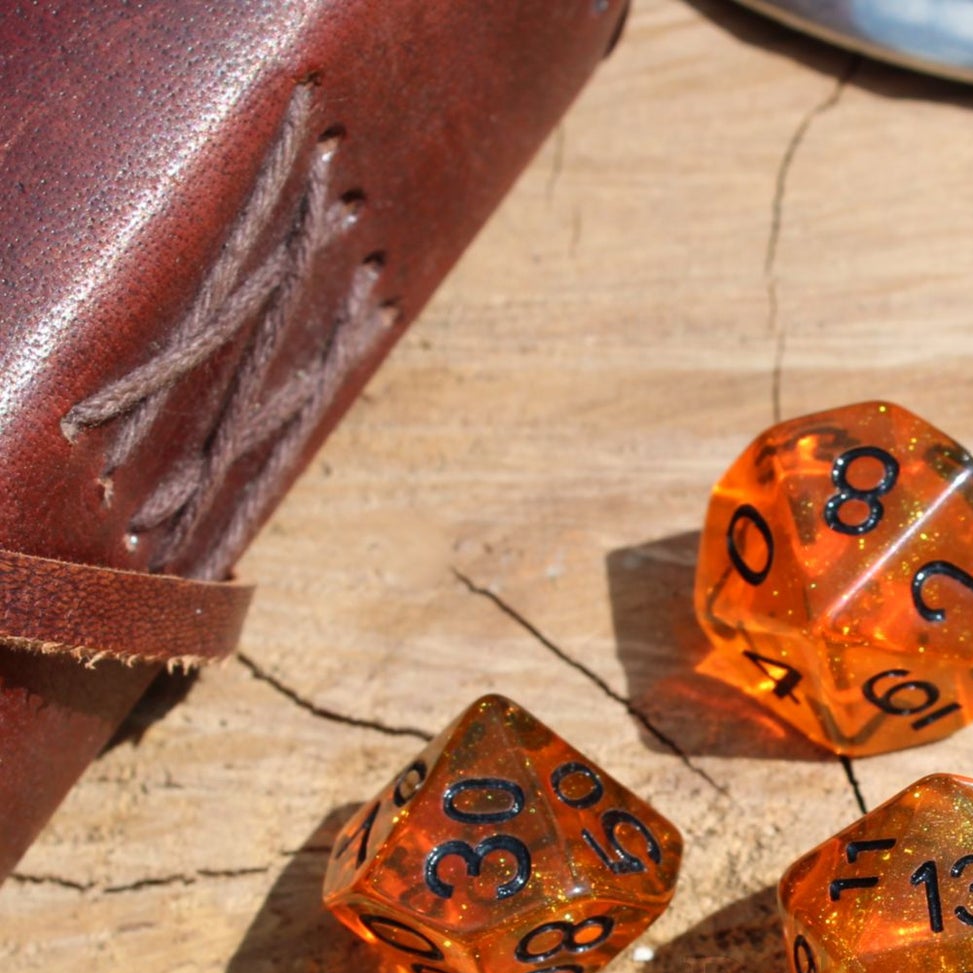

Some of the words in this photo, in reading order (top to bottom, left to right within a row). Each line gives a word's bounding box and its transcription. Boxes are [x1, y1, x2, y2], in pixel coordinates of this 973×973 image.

[823, 445, 900, 536] 8
[727, 504, 774, 586] 0
[425, 776, 531, 899] 30
[551, 761, 662, 875] 50
[829, 838, 896, 900] 11
